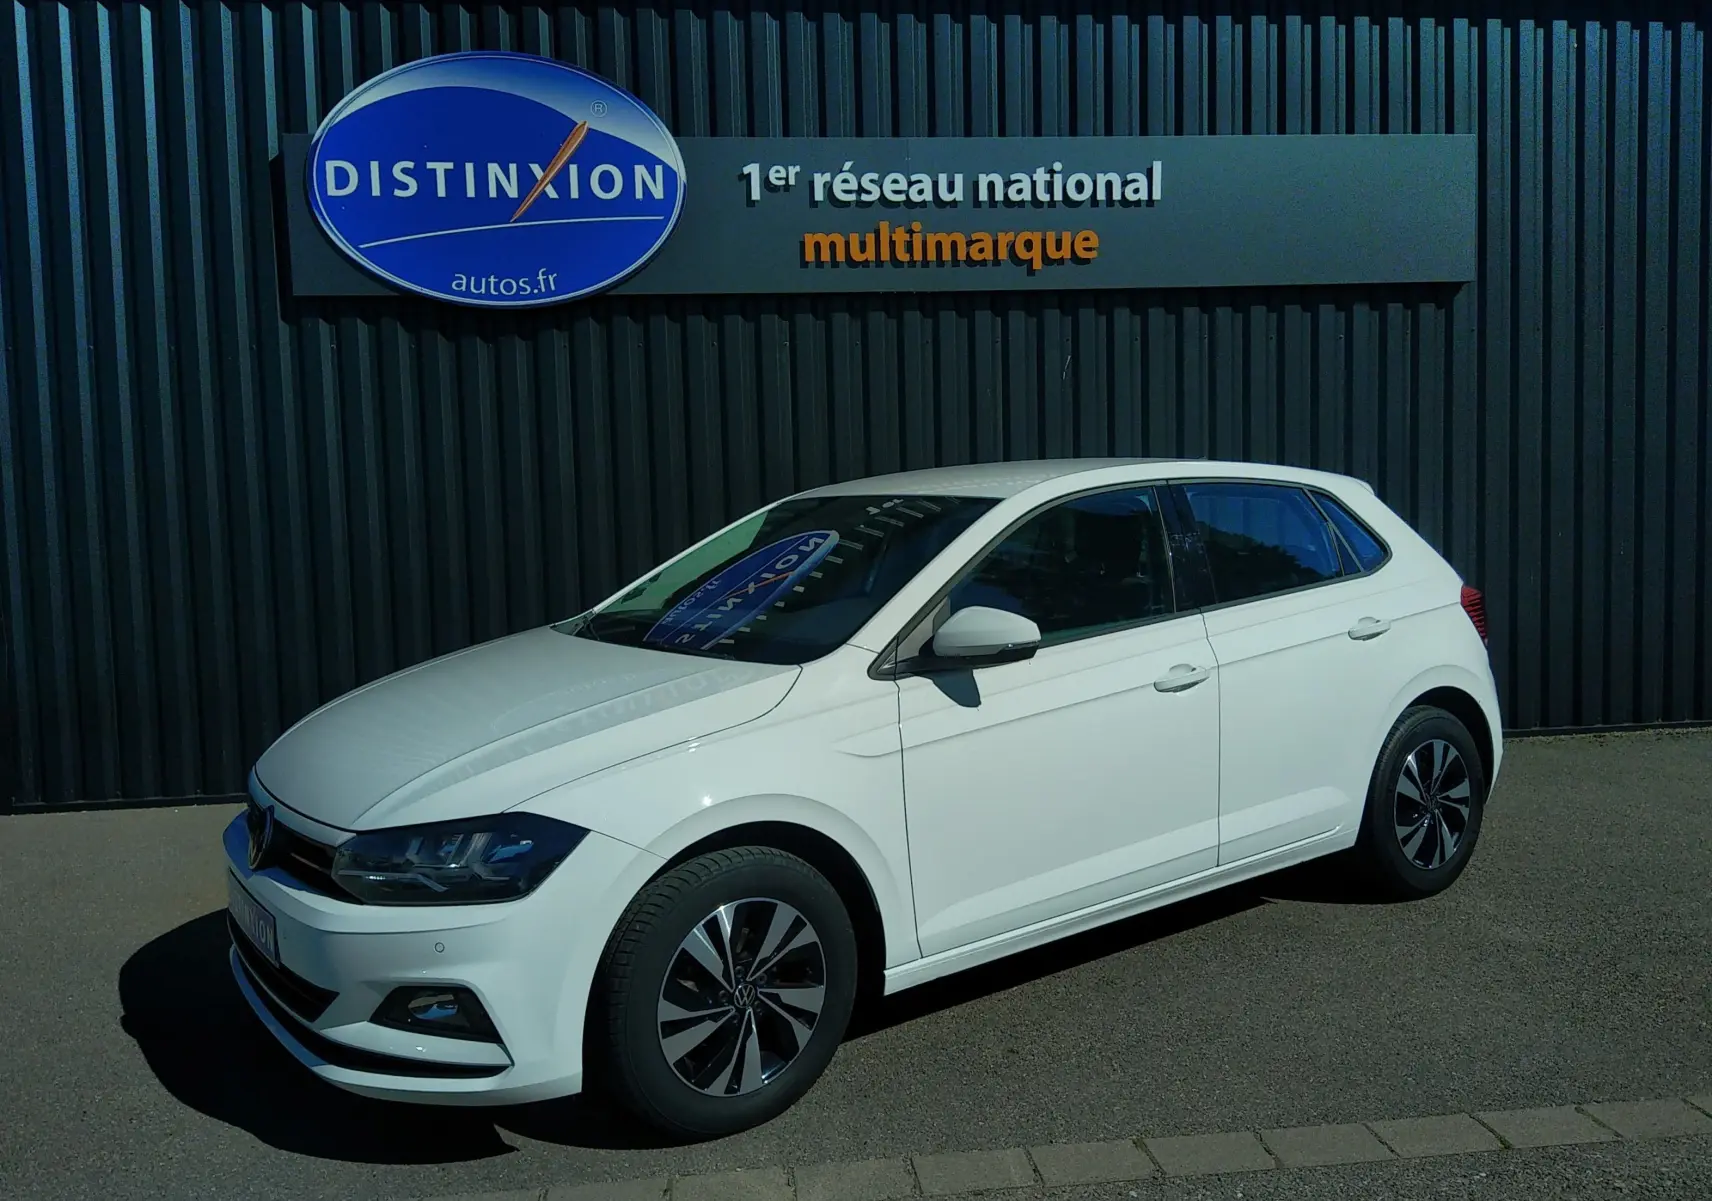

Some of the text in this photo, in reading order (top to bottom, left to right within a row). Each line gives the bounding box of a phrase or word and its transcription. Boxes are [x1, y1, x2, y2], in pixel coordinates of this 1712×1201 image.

[325, 159, 664, 200] DISTINXION
[813, 160, 964, 202] réseau
[978, 160, 1162, 202] national
[803, 220, 1100, 271] multimarque
[451, 268, 557, 296] autos.fr
